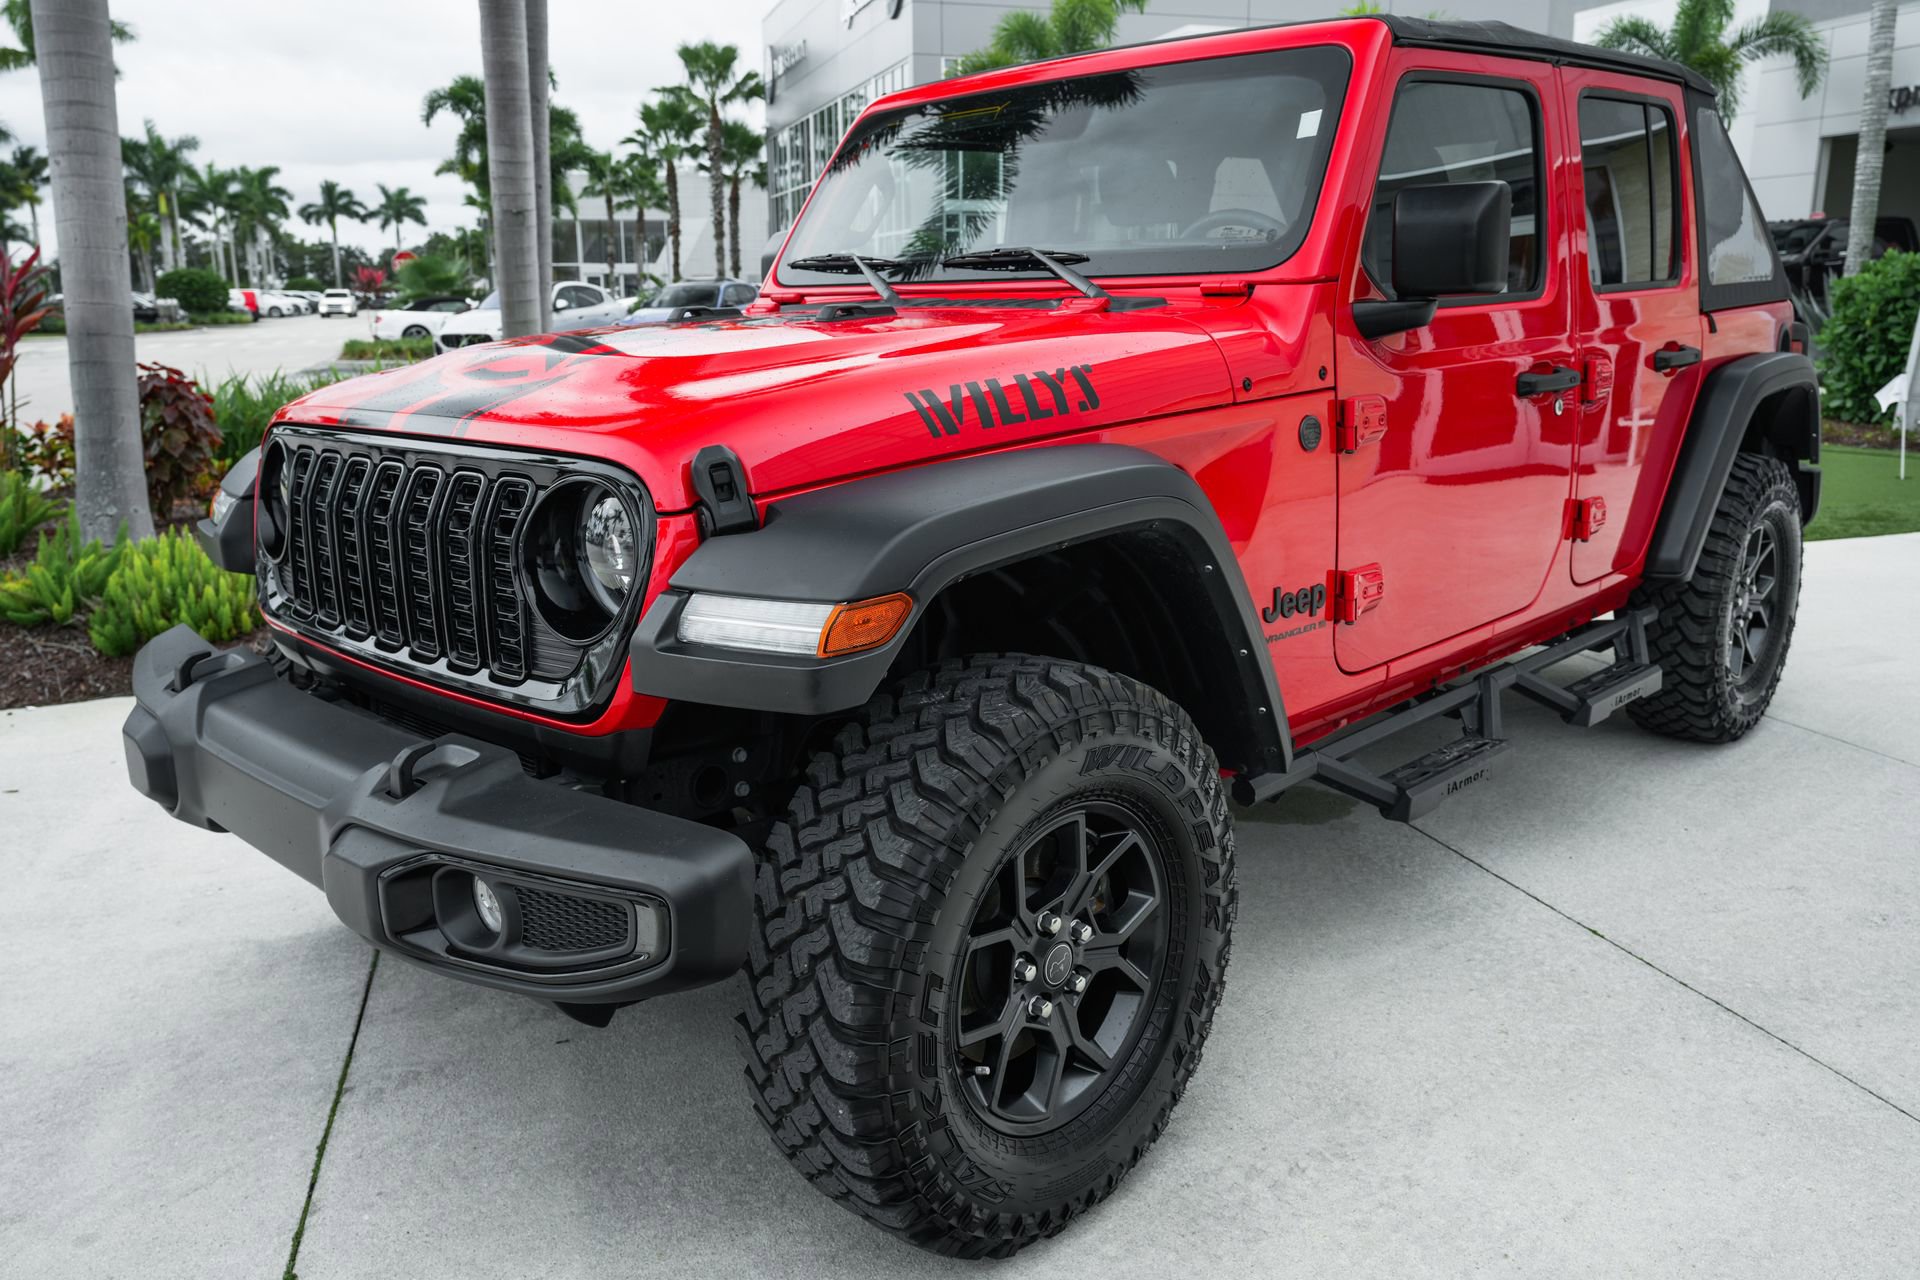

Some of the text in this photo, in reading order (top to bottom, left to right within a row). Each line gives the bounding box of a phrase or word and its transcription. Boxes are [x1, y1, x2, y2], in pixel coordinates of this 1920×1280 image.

[904, 364, 1100, 438] WILLYS
[1262, 583, 1326, 623] Jeep
[1614, 687, 1641, 706] iArmor
[1447, 769, 1486, 795] iArmor
[1079, 743, 1221, 932] WILDPEAK
